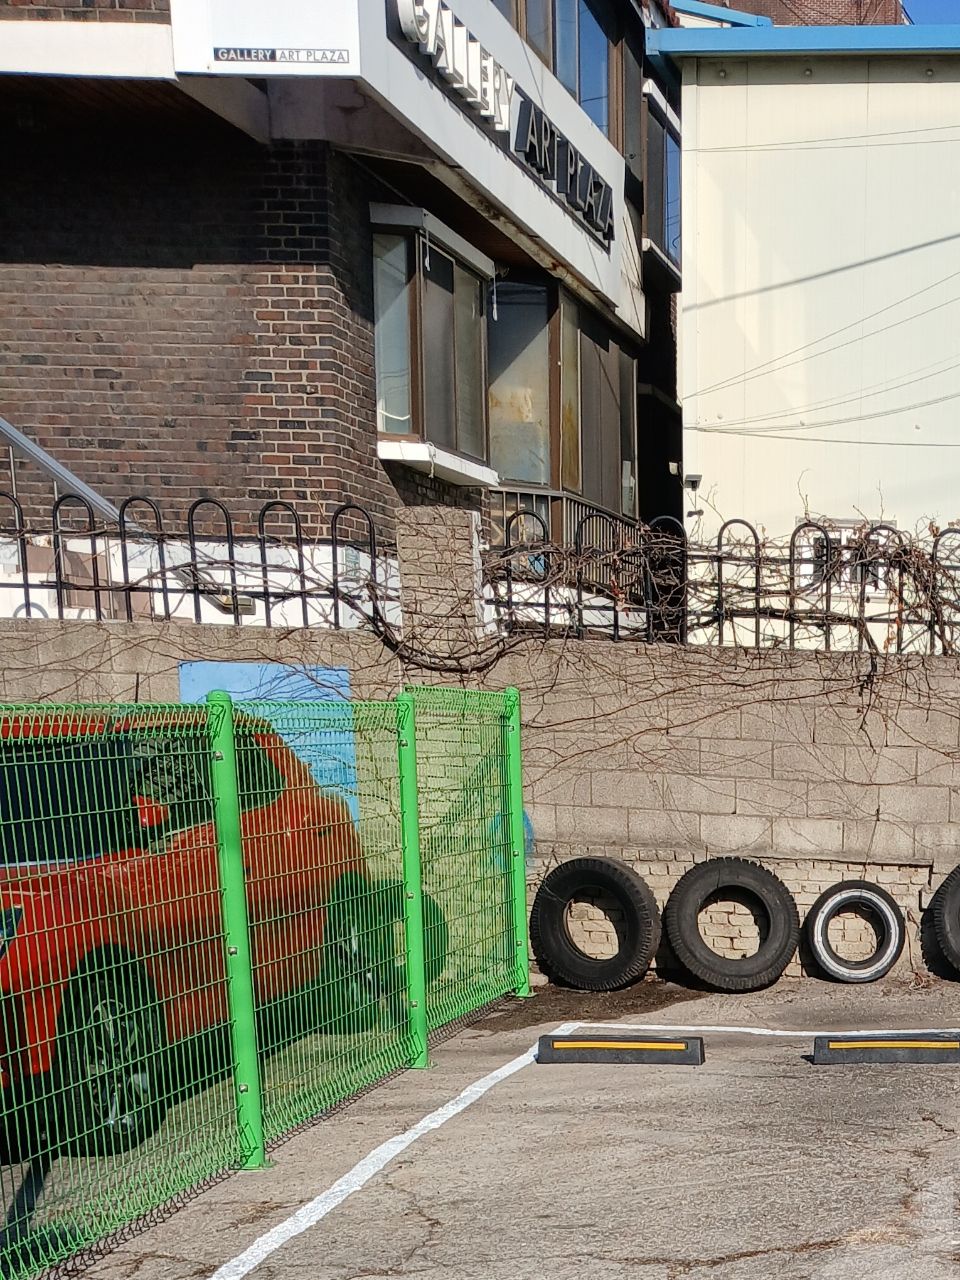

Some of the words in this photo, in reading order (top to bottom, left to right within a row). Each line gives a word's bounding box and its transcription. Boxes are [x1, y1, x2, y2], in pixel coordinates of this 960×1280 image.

[218, 49, 271, 60] GALLERY
[279, 50, 300, 61] ART
[306, 50, 345, 62] PLAZA
[516, 99, 563, 181] ART
[558, 140, 615, 241] PLAZA
